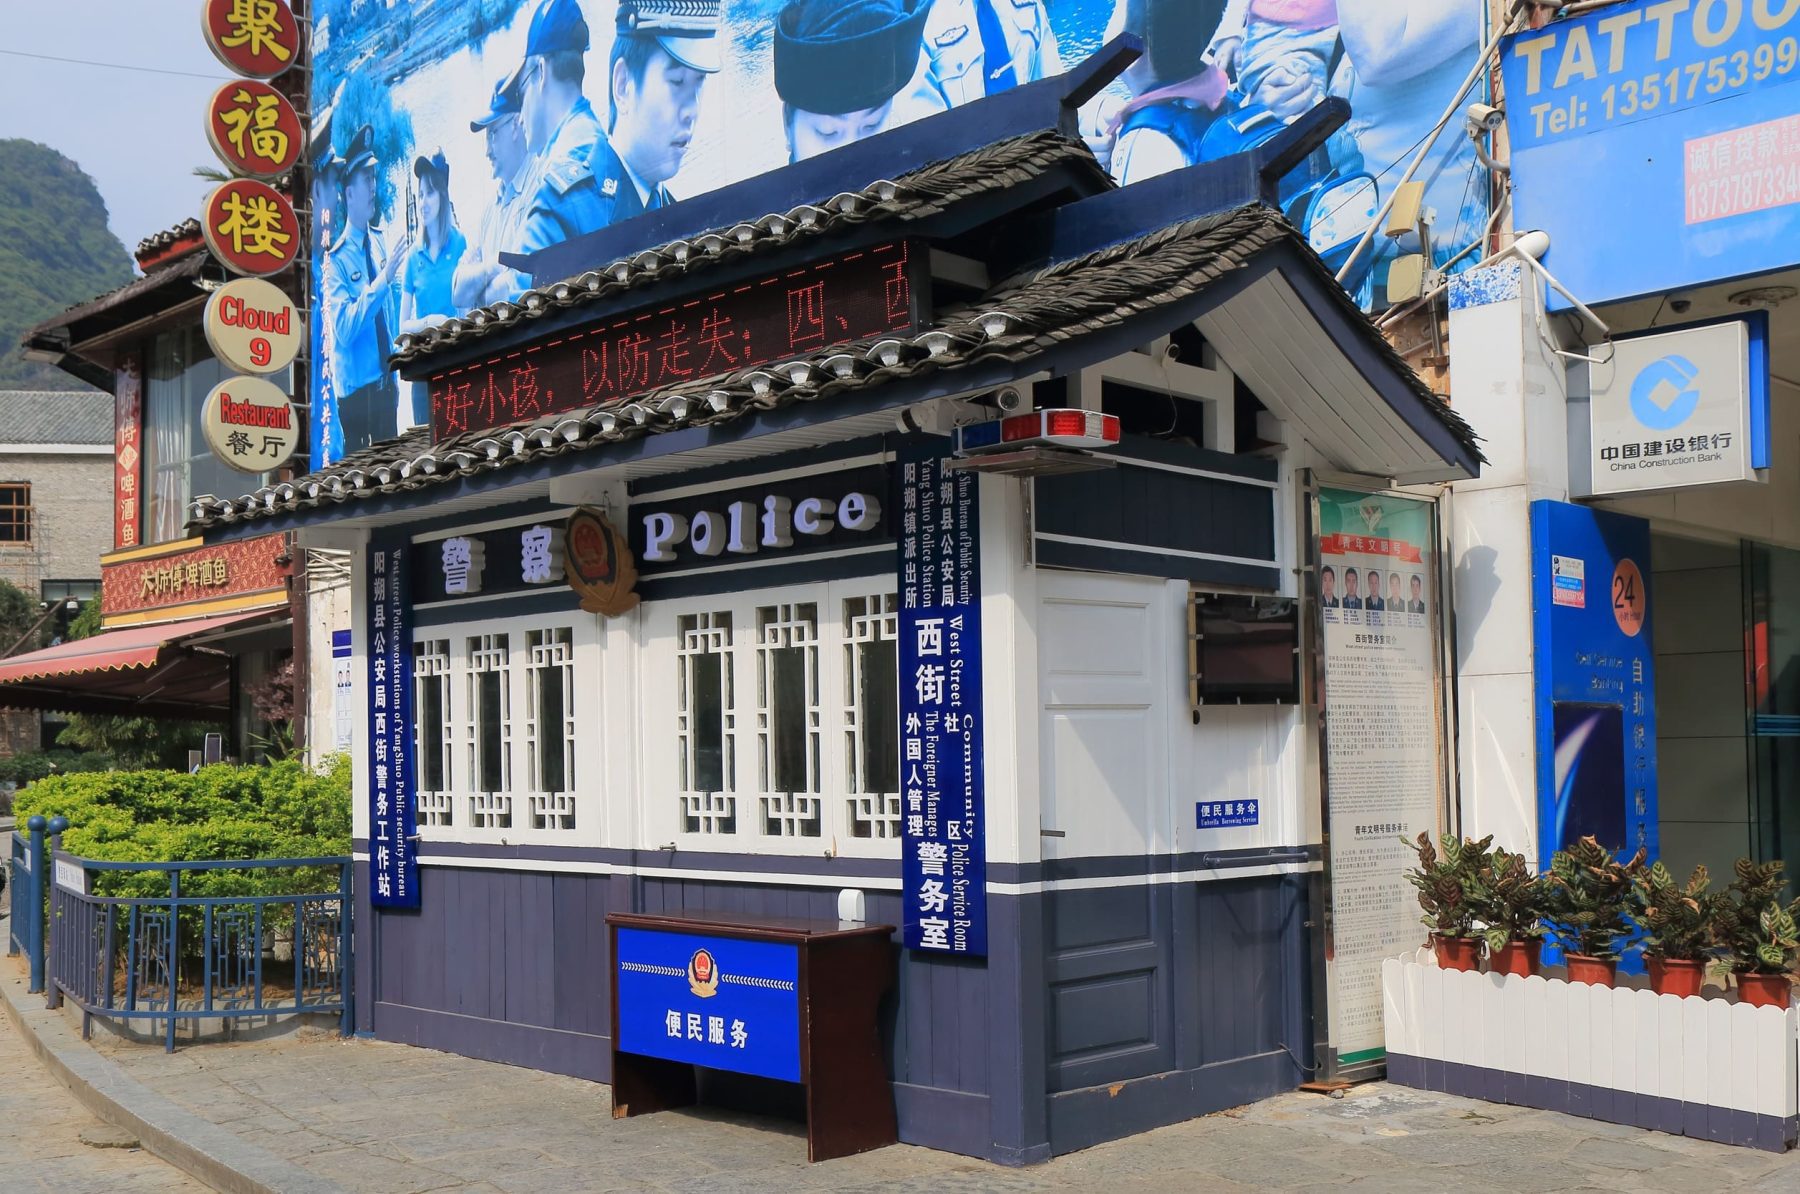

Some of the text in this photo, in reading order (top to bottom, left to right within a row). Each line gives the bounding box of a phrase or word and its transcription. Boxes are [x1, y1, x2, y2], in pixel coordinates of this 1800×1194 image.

[219, 0, 291, 62] 聚
[1530, 36, 1800, 138] Tel: 135175399
[218, 88, 289, 165] 福
[1689, 161, 1800, 220] 1373787334
[218, 191, 291, 260] 楼
[219, 295, 290, 335] Cloud
[249, 337, 272, 367] 9
[220, 392, 291, 430] Restaurant
[225, 430, 286, 458] 餐厅
[1600, 432, 1732, 461] 中国建设银行
[1610, 451, 1722, 471] China Construction Bank
[959, 475, 971, 498] Shuo
[919, 457, 936, 608] Yang Shuo Police Station
[940, 457, 954, 608] 阳朔县公安局
[959, 499, 971, 529] Bureau
[904, 462, 918, 609] 阳朔镇派出所
[959, 531, 972, 542] of
[1343, 535, 1401, 554] 青年文明号
[392, 548, 402, 575] West
[441, 524, 556, 596] 警察
[957, 570, 973, 605] Security
[1614, 574, 1636, 609] 24
[392, 608, 402, 641] Police
[393, 643, 403, 710] workstations
[914, 617, 946, 705] 西街
[949, 614, 964, 707] West Street
[373, 551, 390, 897] 阳朔县公安局西街警务工作站
[394, 712, 403, 725] of
[905, 712, 924, 837] 外国人管理
[922, 710, 940, 837] The Foreigner Manages
[963, 713, 976, 839] Community
[395, 780, 405, 814] Public
[1201, 802, 1257, 817] 便民服务伞
[396, 816, 406, 858] security
[397, 860, 407, 897] bureau
[917, 841, 951, 950] 警务室
[951, 843, 972, 951] Police Service Room
[665, 1008, 748, 1050] 便民服务
